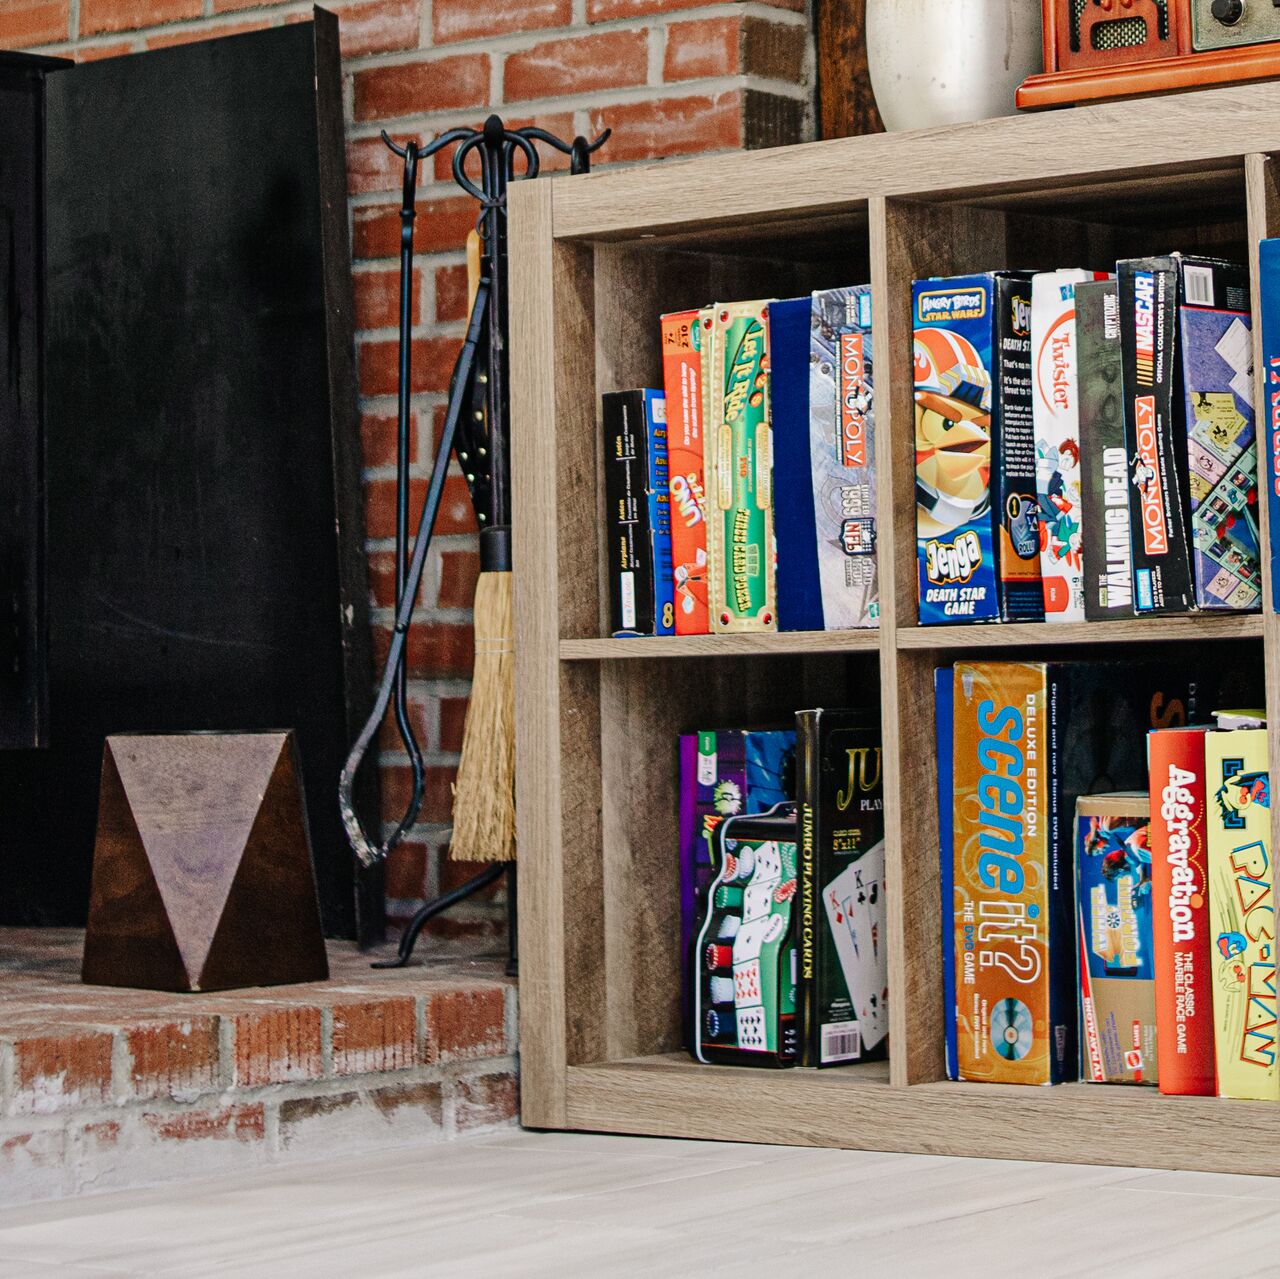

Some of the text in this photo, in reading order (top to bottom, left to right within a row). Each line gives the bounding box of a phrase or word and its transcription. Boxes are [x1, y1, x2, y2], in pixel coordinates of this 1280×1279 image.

[923, 294, 980, 312] ANGRY BIRDS
[923, 308, 980, 321] STAR WARS
[1013, 299, 1031, 331] Jen
[1135, 276, 1153, 351] NASCAR
[1157, 303, 1165, 350] COLLECTOR'S
[742, 328, 764, 360] Let
[1003, 338, 1021, 350] DEATH
[733, 360, 755, 378] It
[1051, 333, 1071, 409] Twister
[724, 379, 750, 422] Ride
[843, 337, 864, 464] MONOPOLY
[1138, 402, 1165, 549] MONOPOLY
[669, 476, 703, 527] UNO
[841, 484, 860, 515] 1999
[861, 484, 870, 515] LIMITED
[1163, 491, 1172, 517] Brothers
[845, 522, 861, 550] NFL
[1099, 447, 1132, 608] THE WALKING DEAD
[733, 508, 752, 612] THREE CARD POKER
[851, 558, 862, 586] IRON
[862, 557, 872, 585] GRID
[928, 533, 981, 580] Jenga
[926, 587, 986, 602] DEATH STAR
[944, 601, 975, 615] GAME
[1026, 694, 1036, 837] DELUXE EDITION
[977, 700, 1041, 984] scene it?
[1161, 764, 1198, 943] Aggravation
[802, 803, 812, 979] JUMBO PLAYING CARDS
[964, 900, 975, 984] THE DVD GAME
[1229, 840, 1277, 1068] PAC-MAN
[1174, 951, 1187, 1054] MARBLE RACE GAME
[1183, 951, 1195, 1017] THE CLASSIC
[1094, 1063, 1102, 1077] TV
